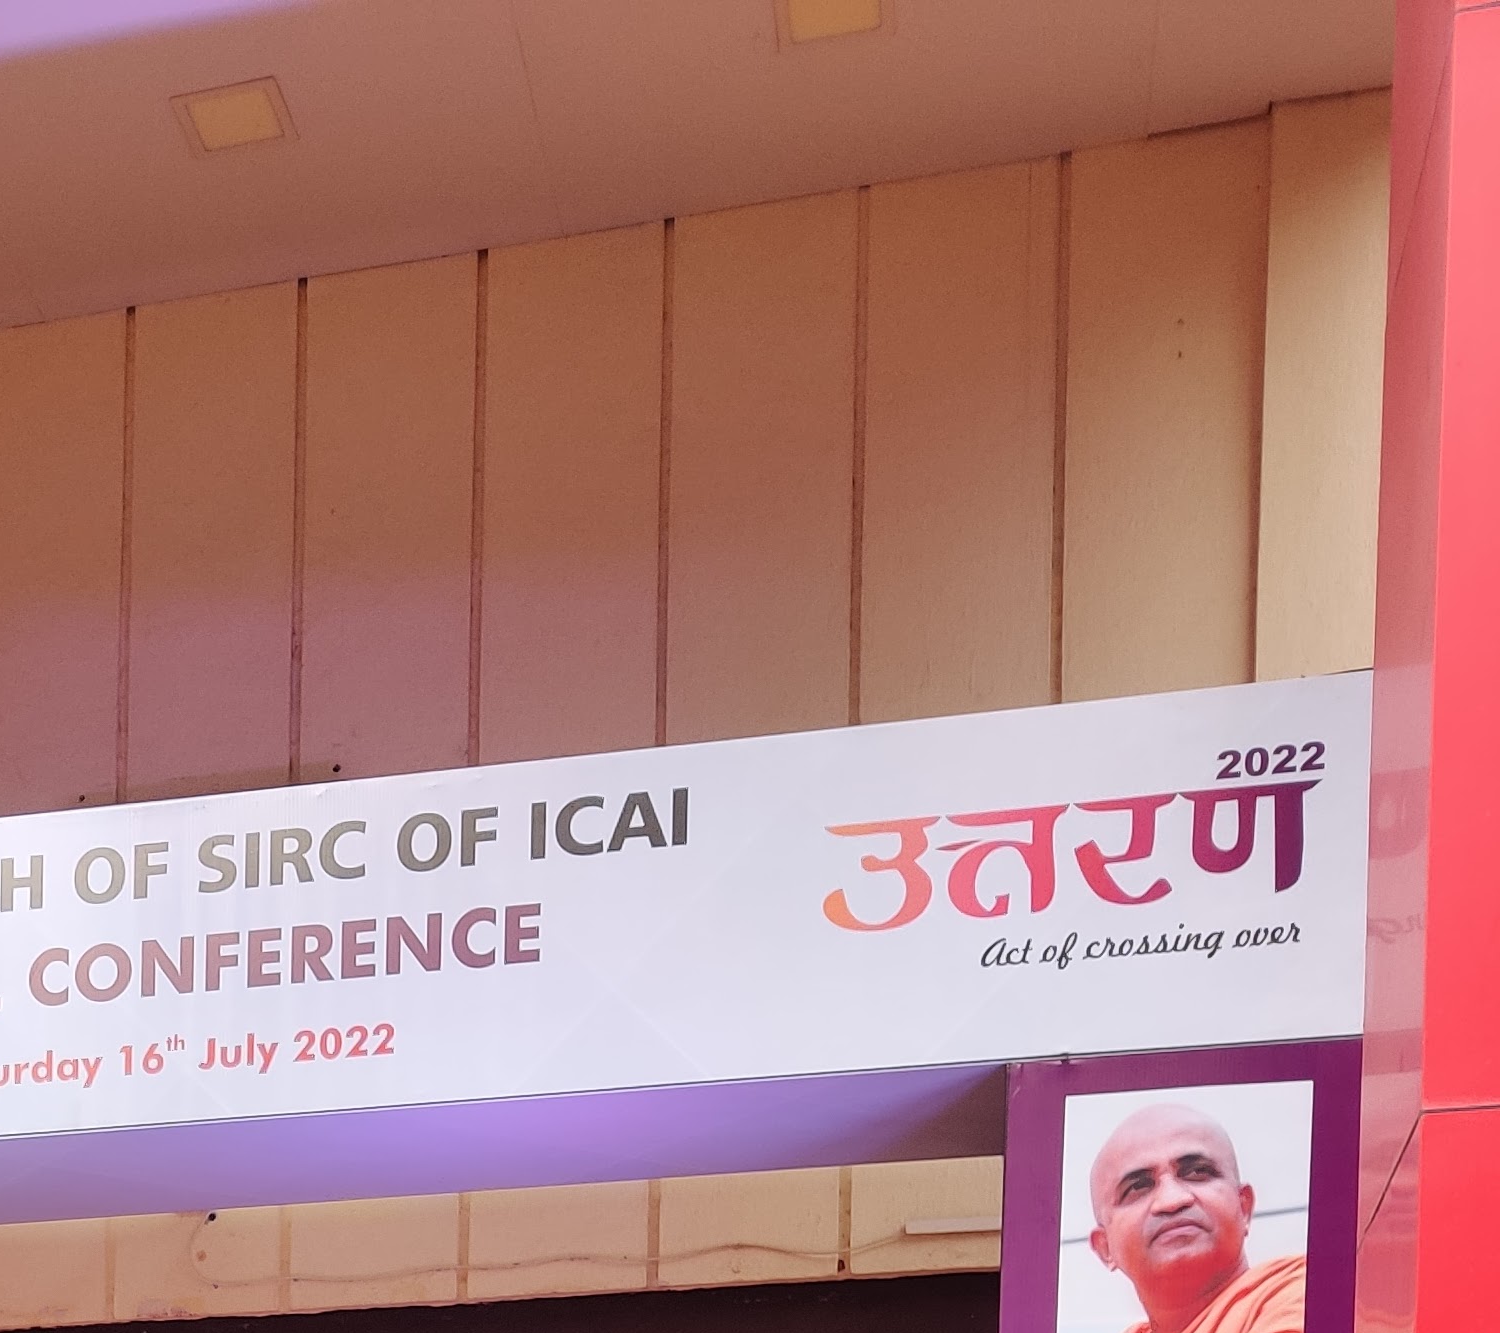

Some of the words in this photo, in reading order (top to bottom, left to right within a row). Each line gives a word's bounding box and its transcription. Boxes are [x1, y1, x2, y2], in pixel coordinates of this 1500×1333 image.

[1216, 741, 1326, 779] 2022
[73, 841, 170, 905] OF
[196, 820, 367, 894] SIRC
[396, 807, 499, 871] OF
[529, 787, 691, 860] ICAI
[28, 903, 543, 1007] CONFERENCE
[981, 936, 1031, 967] Act
[1039, 933, 1074, 970] of
[1083, 923, 1225, 960] crossing
[1231, 922, 1301, 948] over
[198, 1031, 278, 1075] July
[292, 1024, 397, 1063] 2022
